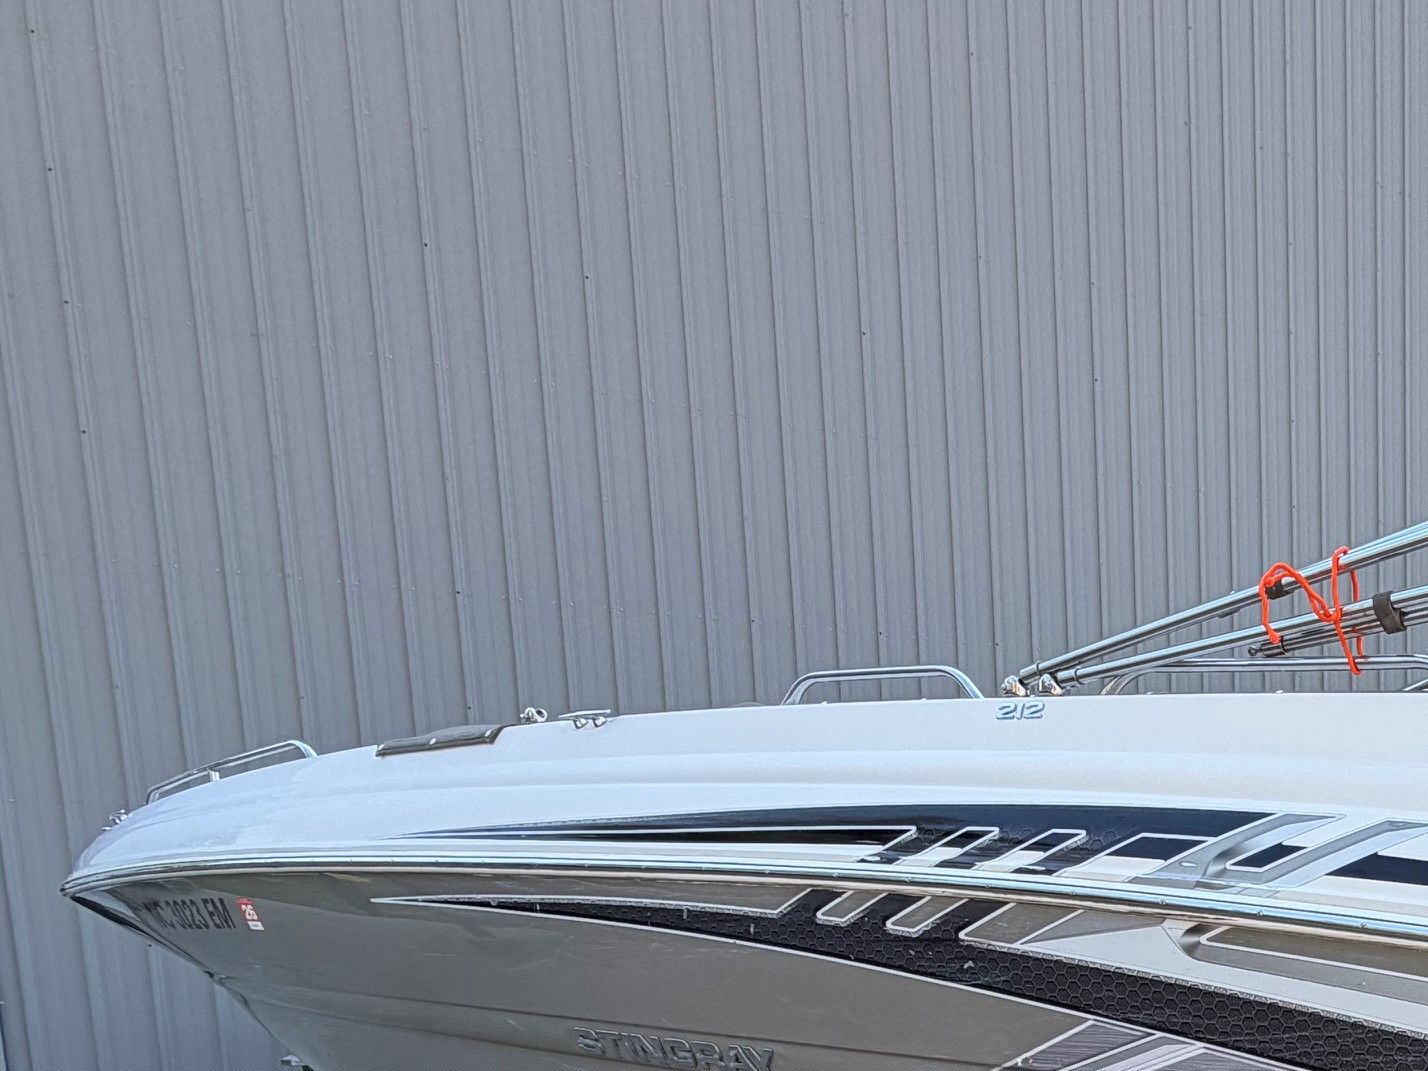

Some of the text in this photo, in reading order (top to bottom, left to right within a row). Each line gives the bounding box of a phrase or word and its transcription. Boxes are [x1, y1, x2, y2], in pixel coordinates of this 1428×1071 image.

[996, 701, 1045, 720] 212
[200, 897, 236, 930] EM
[241, 904, 259, 921] 26
